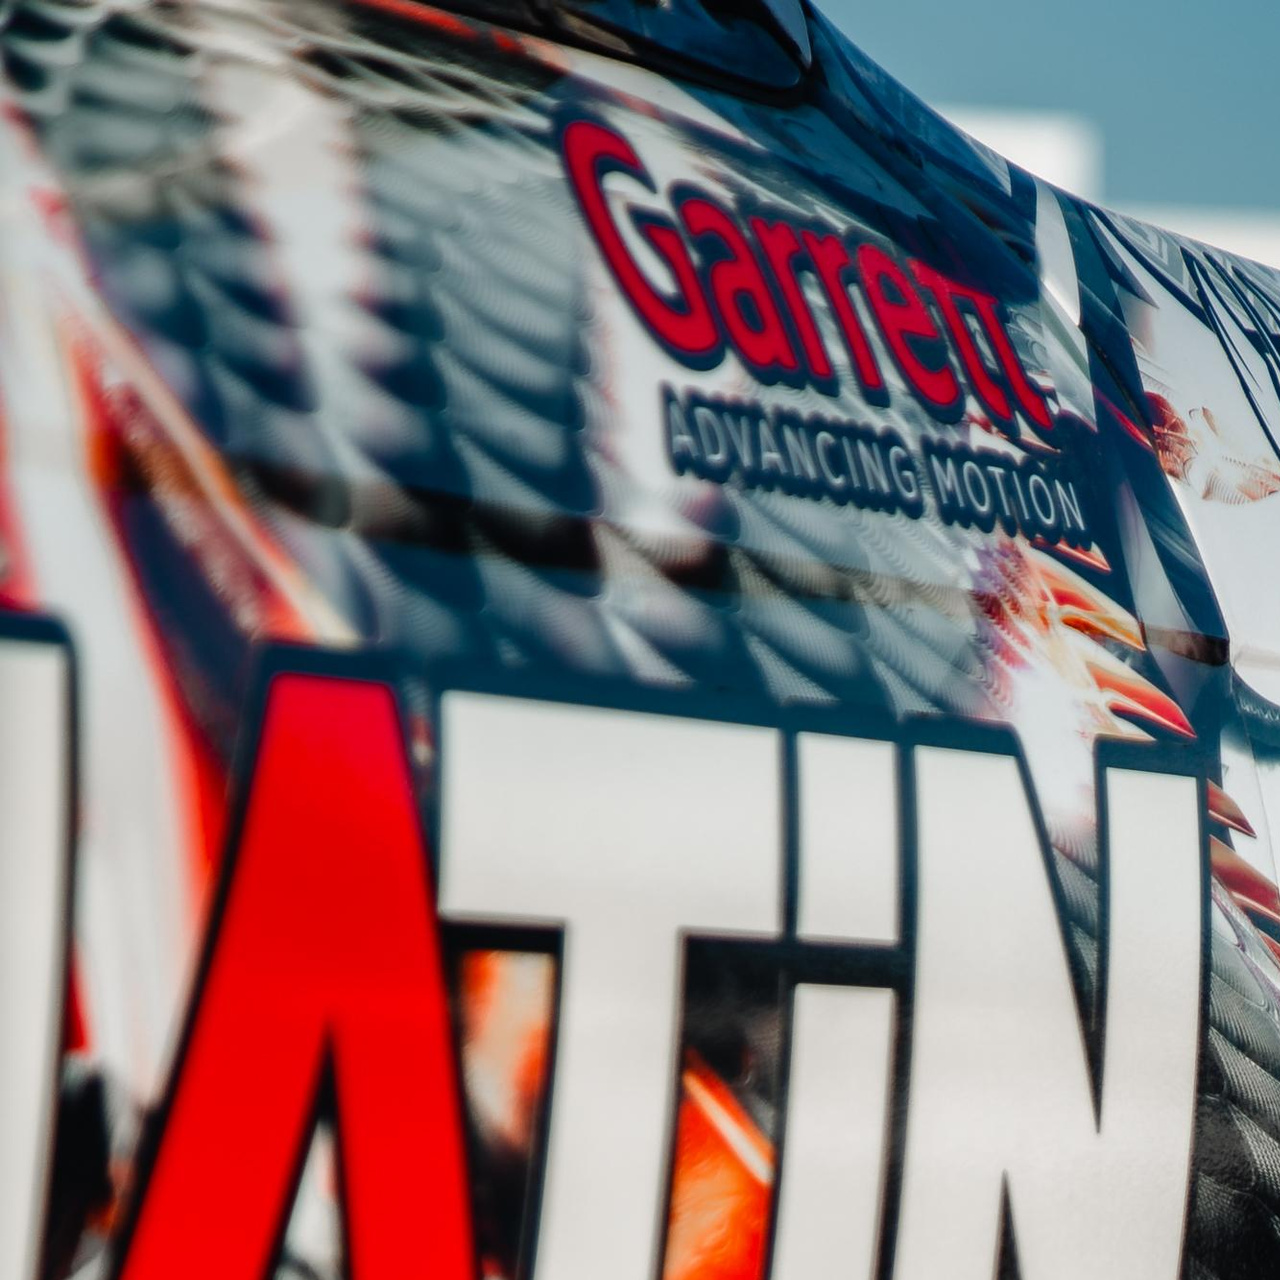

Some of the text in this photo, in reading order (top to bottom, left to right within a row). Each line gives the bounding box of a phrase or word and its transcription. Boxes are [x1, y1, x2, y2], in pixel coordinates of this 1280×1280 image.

[564, 122, 1054, 430] Garrett
[668, 400, 1086, 533] ADVANCING MOTION
